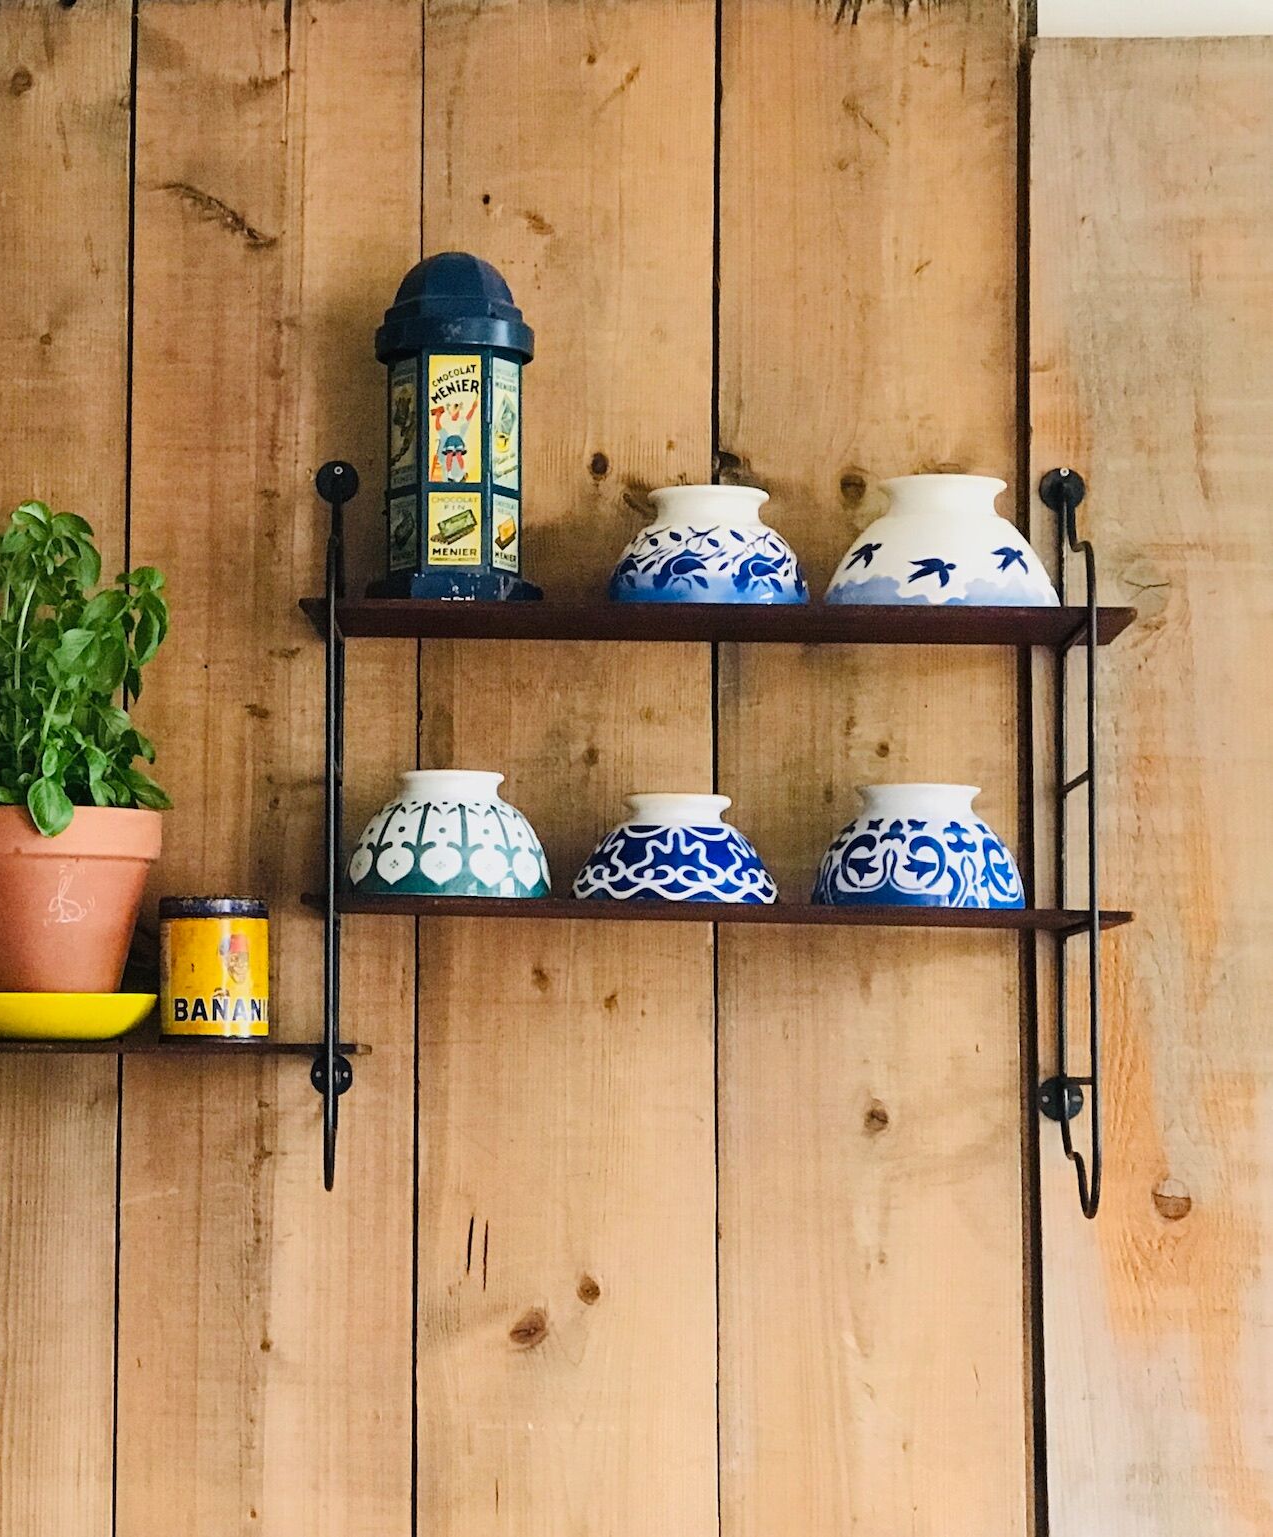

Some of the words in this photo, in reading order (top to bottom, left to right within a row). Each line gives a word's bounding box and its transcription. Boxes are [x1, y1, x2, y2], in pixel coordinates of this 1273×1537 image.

[431, 364, 477, 387] CHOCOLAT
[431, 496, 478, 504] CHOCOLAT
[432, 548, 477, 556] MENIER
